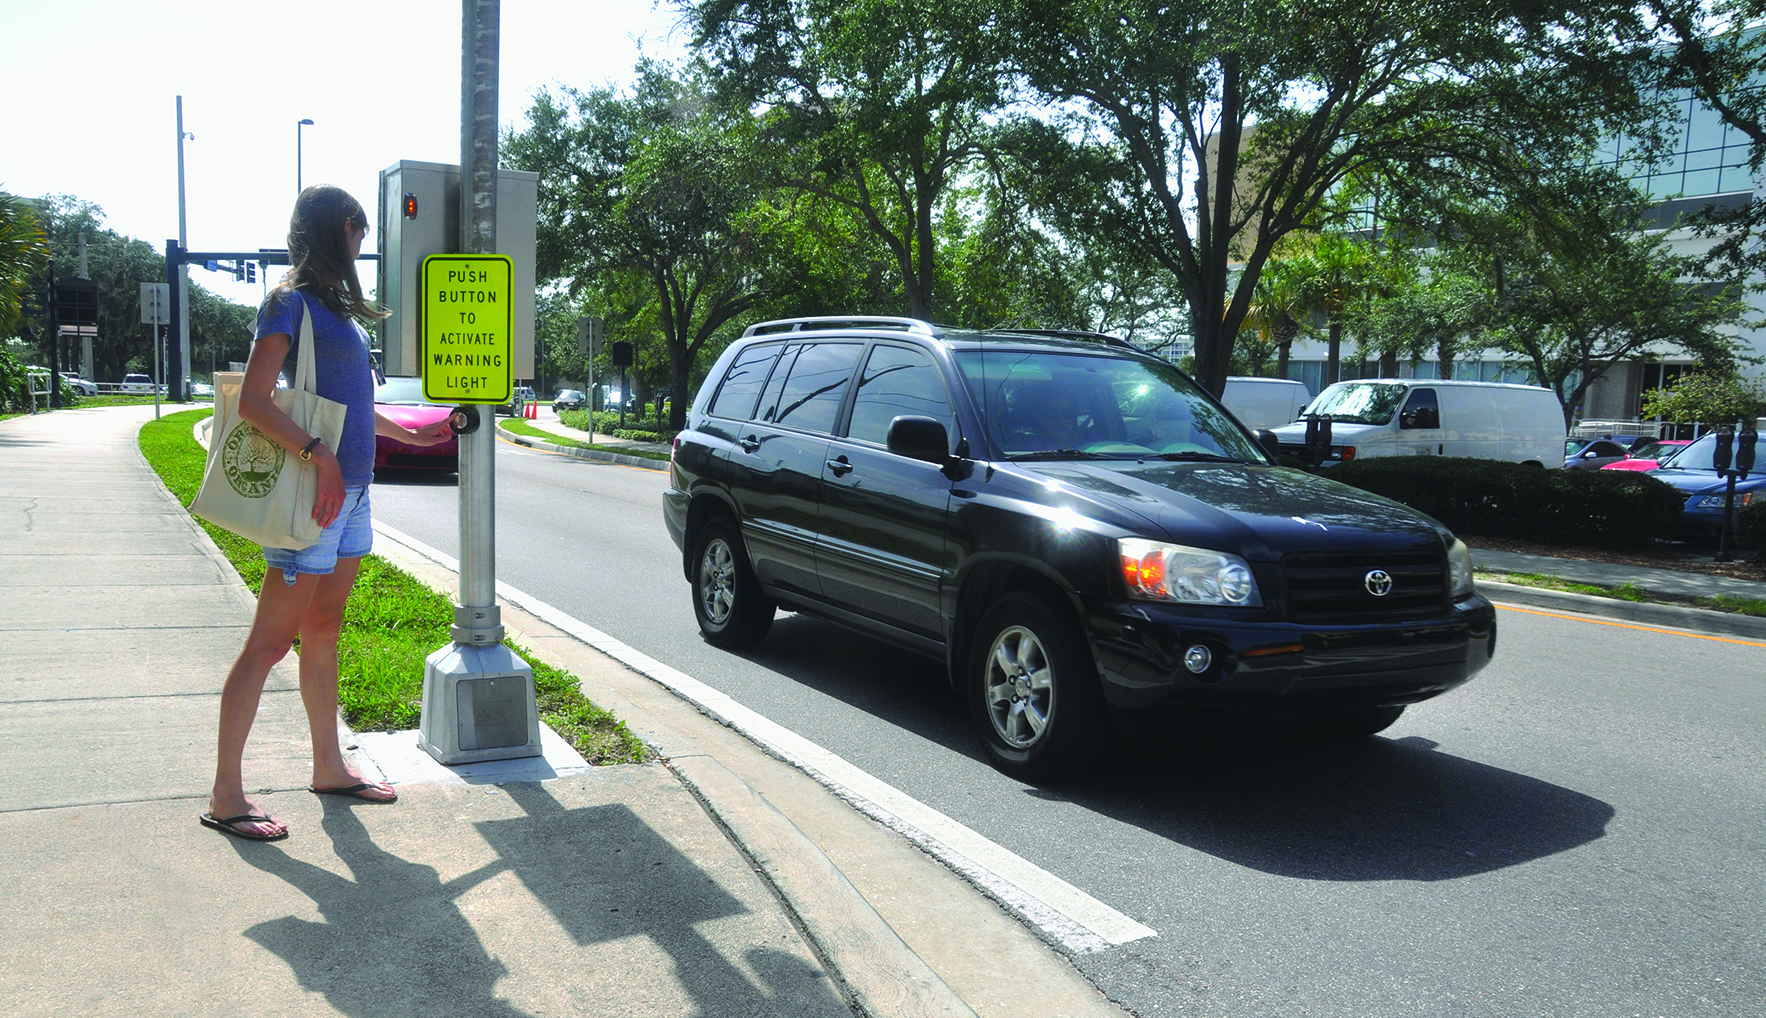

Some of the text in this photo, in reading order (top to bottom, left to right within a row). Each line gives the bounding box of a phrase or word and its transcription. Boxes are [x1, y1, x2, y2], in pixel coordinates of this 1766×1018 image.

[448, 270, 487, 283] PUSH
[439, 291, 497, 303] BUTTON
[459, 312, 476, 325] TO
[440, 332, 495, 345] ACTIVATE
[433, 354, 502, 367] WARNING
[446, 376, 488, 389] LIGHT
